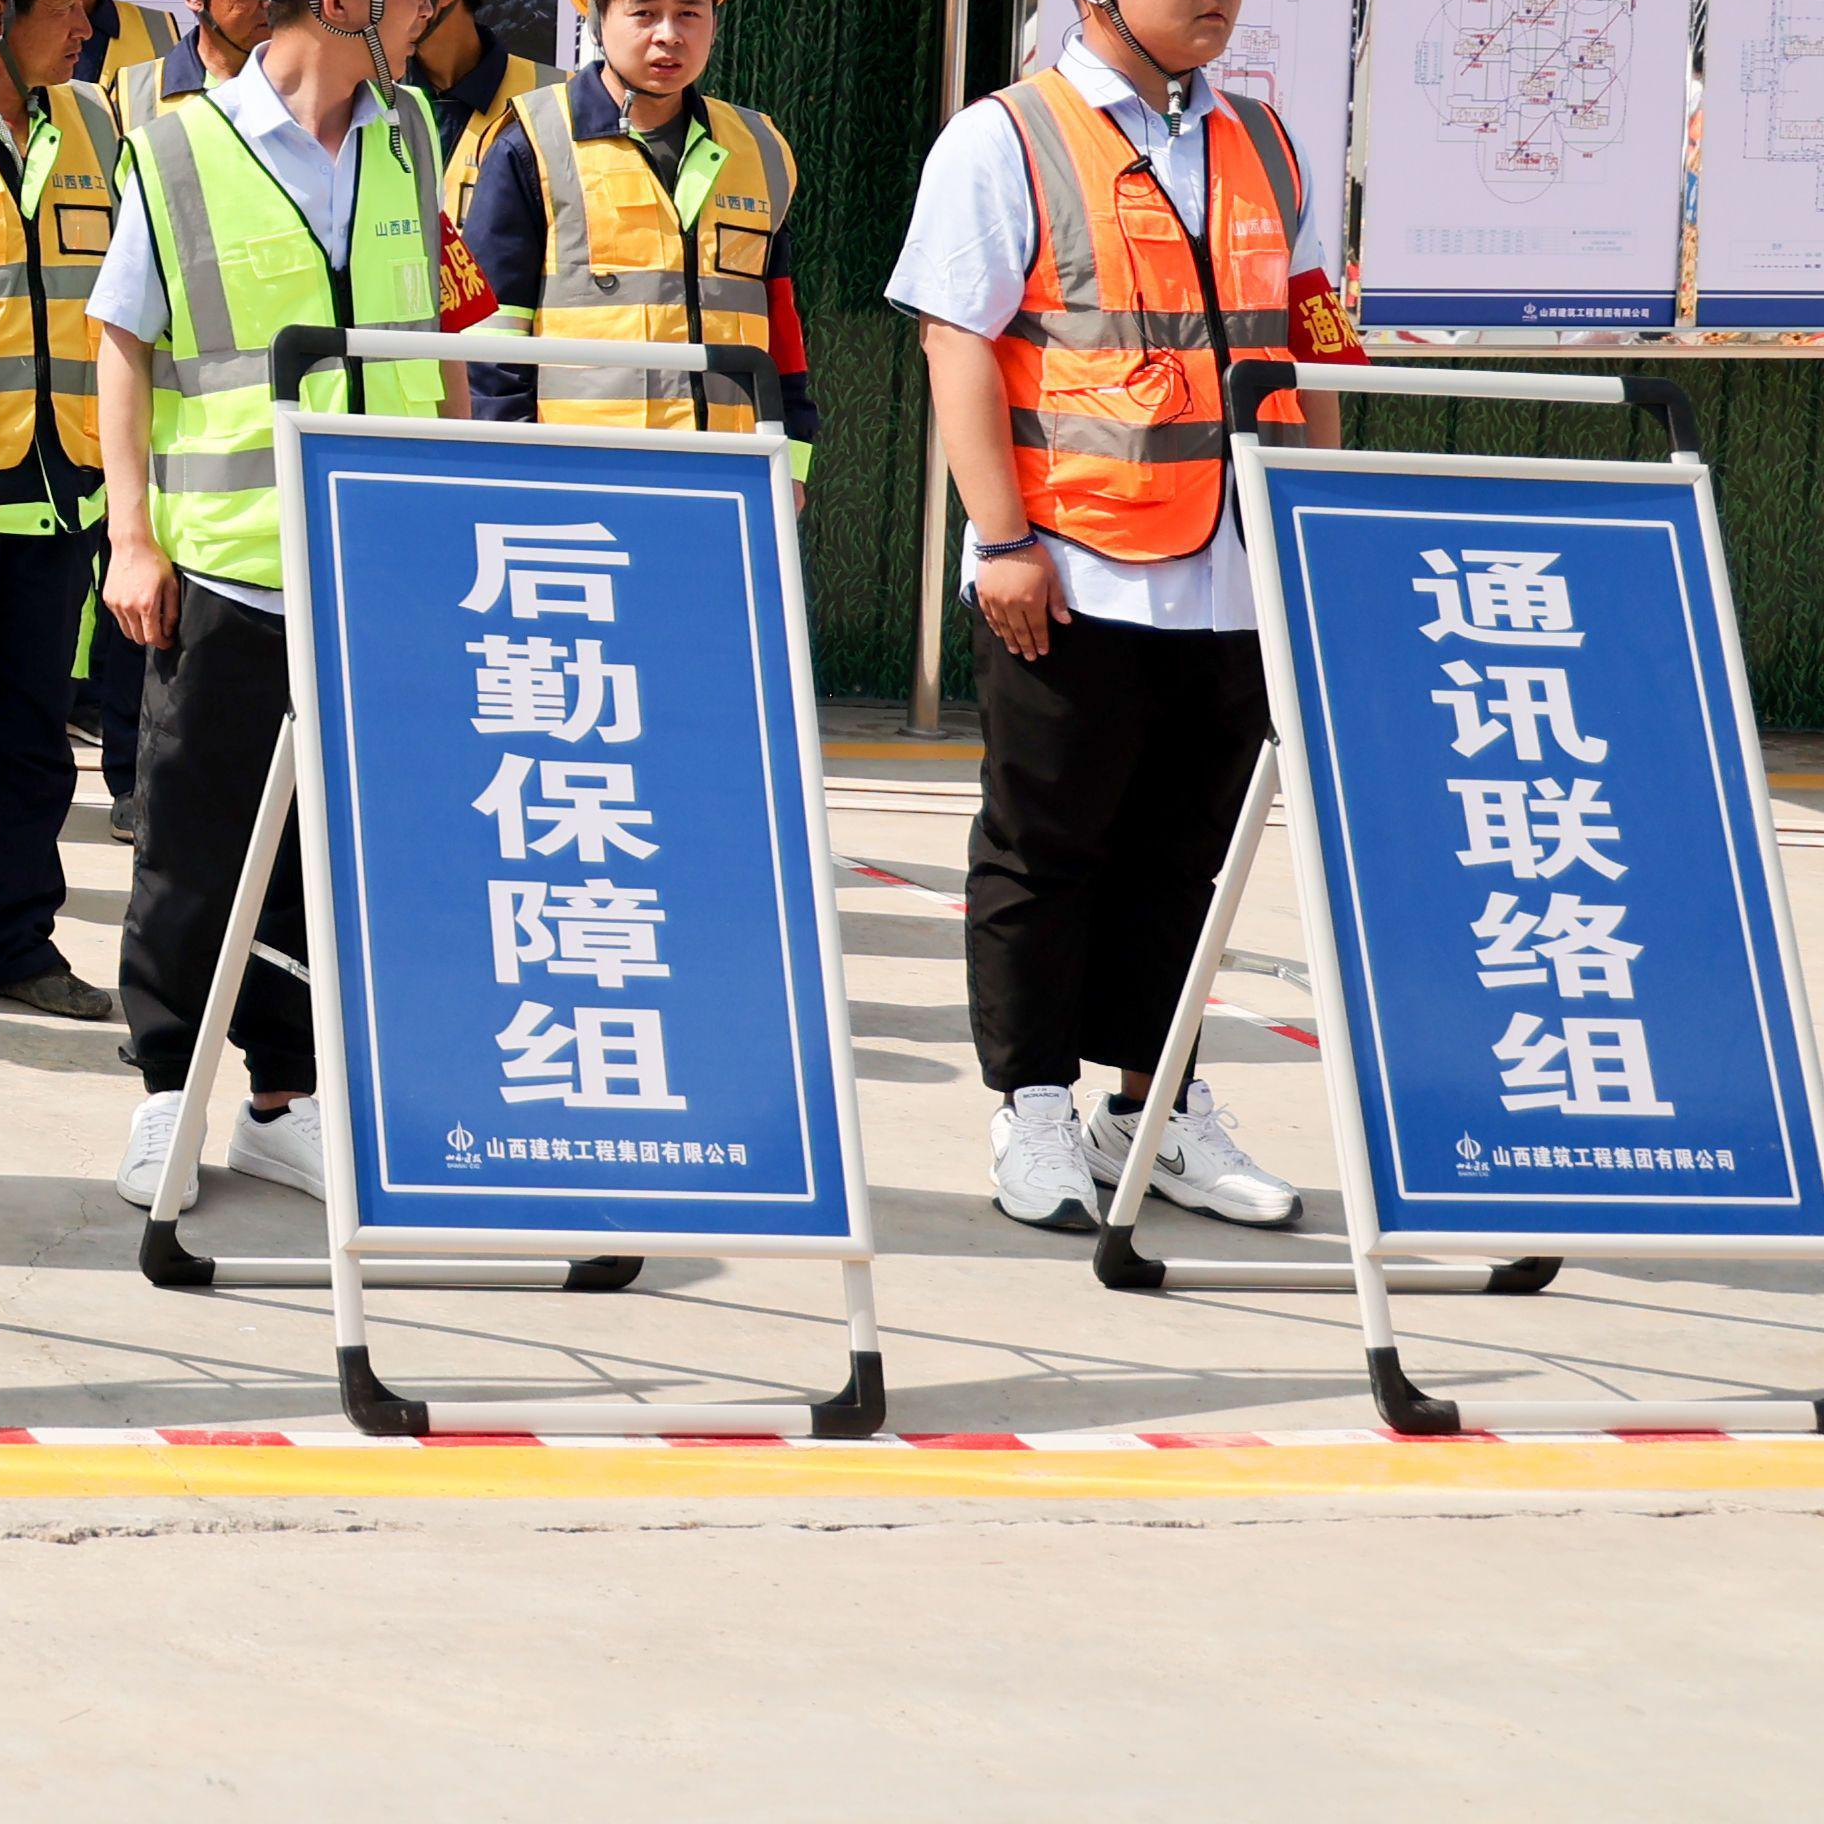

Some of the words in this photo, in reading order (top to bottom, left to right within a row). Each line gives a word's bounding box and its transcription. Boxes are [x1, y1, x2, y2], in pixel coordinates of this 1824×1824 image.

[52, 173, 106, 190] 山西建工
[715, 192, 771, 215] 山西建工
[375, 220, 420, 237] 山西建工
[1539, 307, 1650, 320] 山西建筑工程集团有限公司
[459, 522, 687, 1111] 后勤保障组
[1412, 548, 1675, 1118] 通讯联络组
[485, 1138, 748, 1167] 山西建筑工程集团有限公司
[1492, 1145, 1735, 1172] 山西建筑工程集团有限公司
